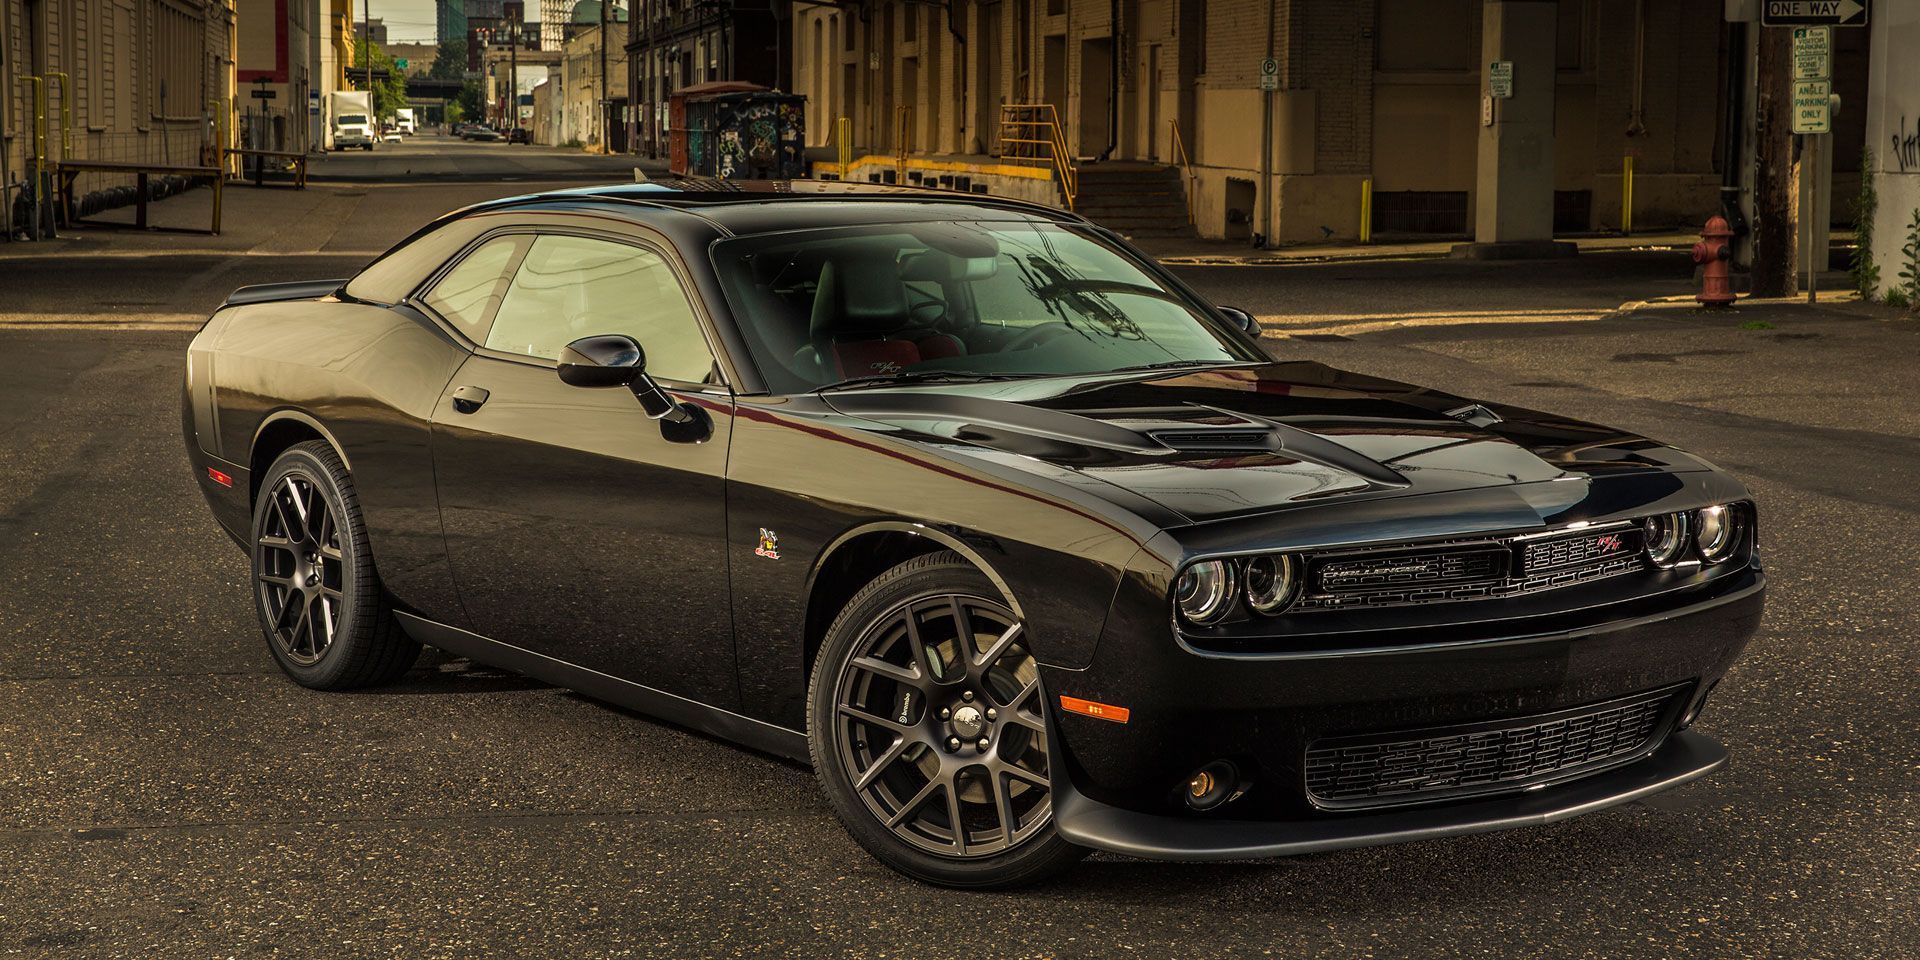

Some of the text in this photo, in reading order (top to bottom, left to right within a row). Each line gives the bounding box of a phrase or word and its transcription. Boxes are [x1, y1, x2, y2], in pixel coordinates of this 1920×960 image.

[1771, 2, 1840, 15] ONE WAY
[1798, 86, 1823, 95] ANGLE
[1795, 97, 1827, 107] PARKING
[1801, 110, 1821, 119] ONLY
[1324, 565, 1426, 577] CHALLENGER
